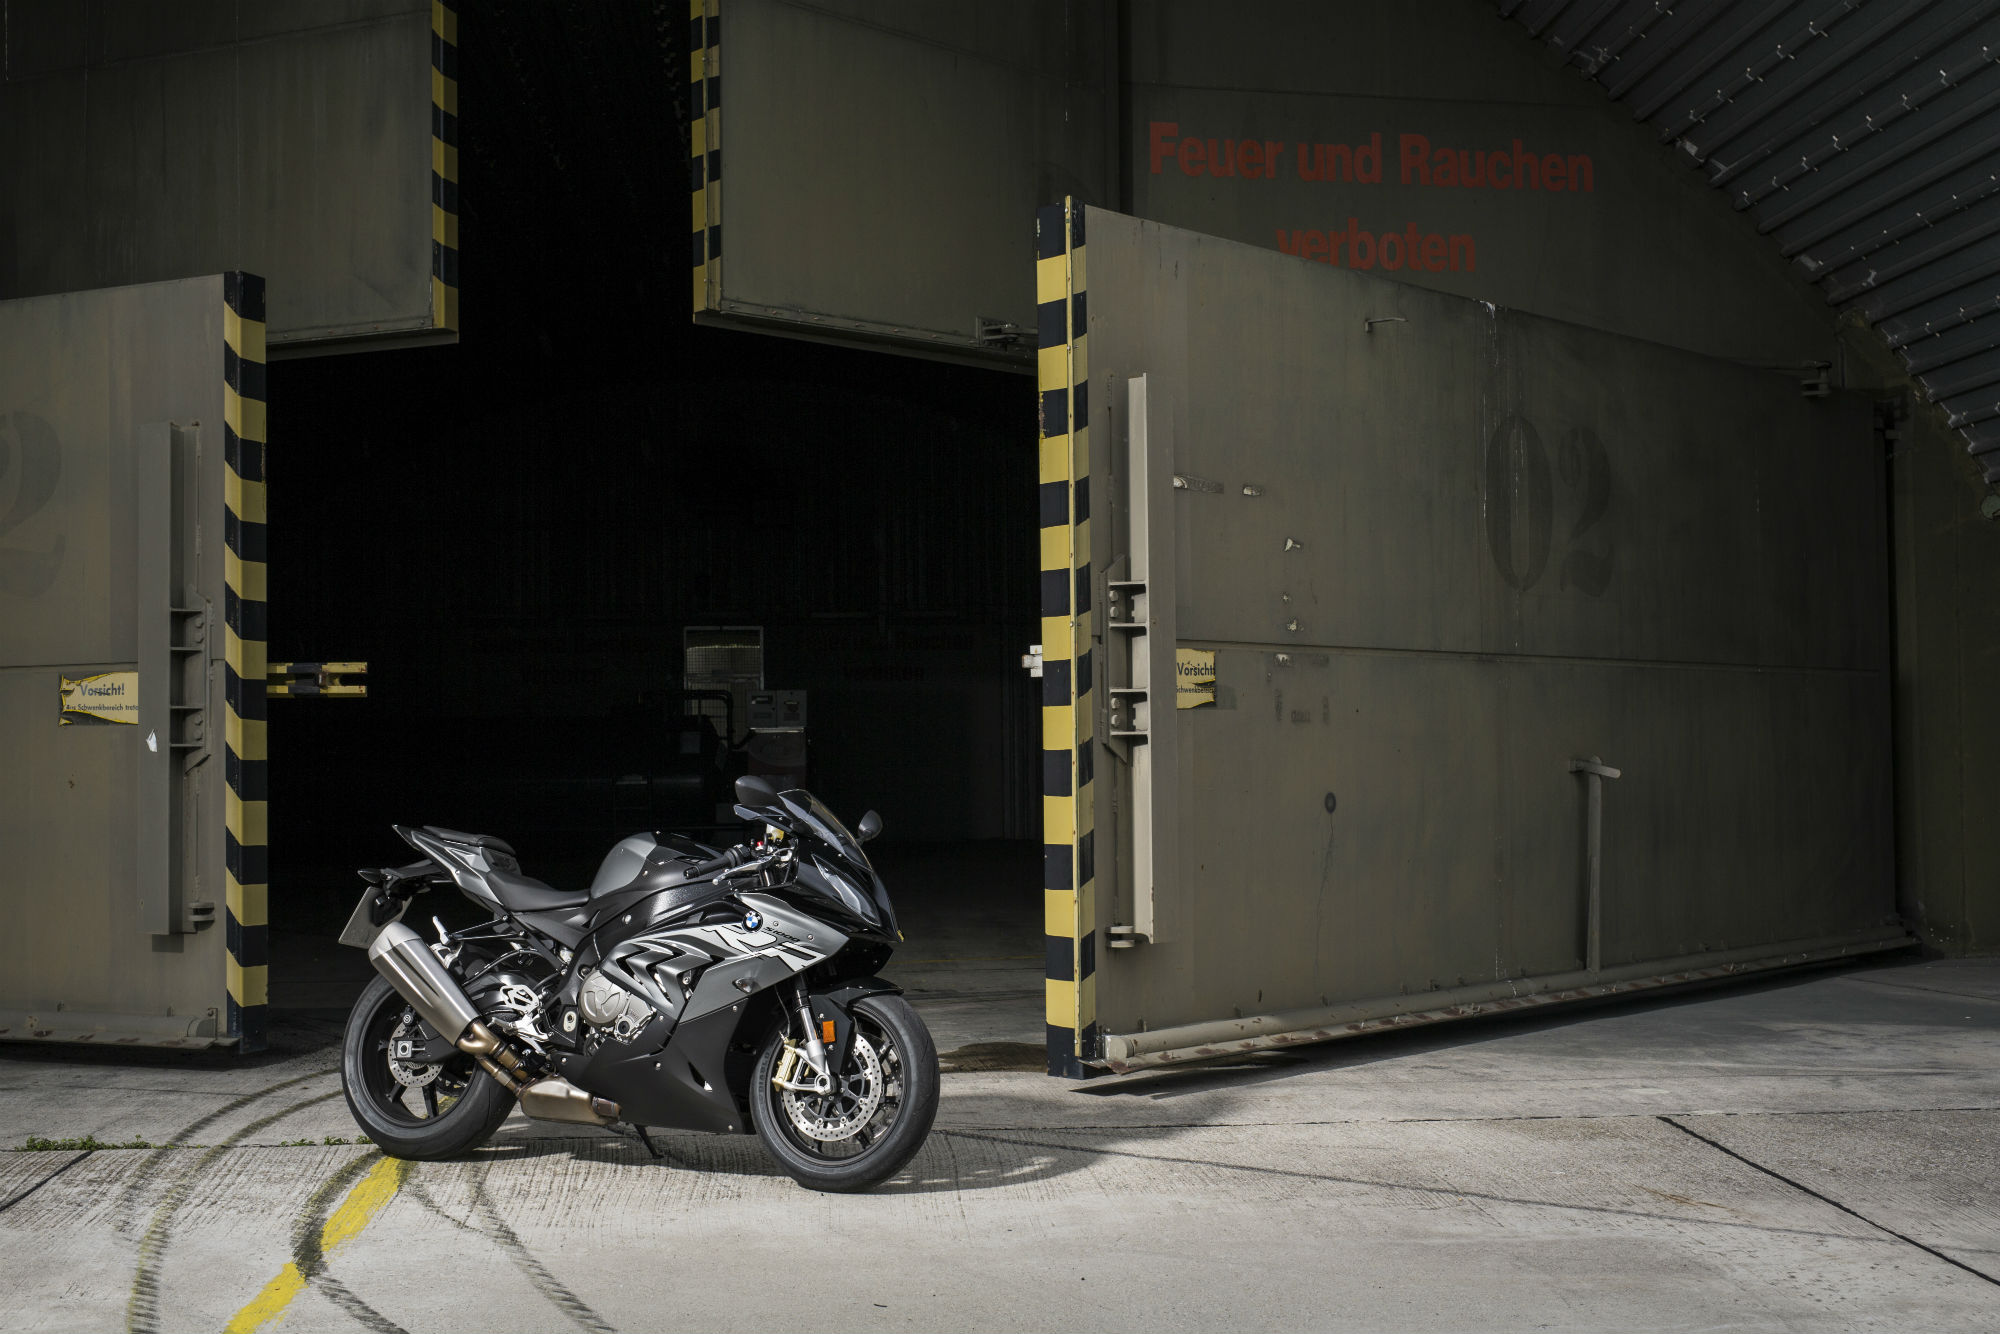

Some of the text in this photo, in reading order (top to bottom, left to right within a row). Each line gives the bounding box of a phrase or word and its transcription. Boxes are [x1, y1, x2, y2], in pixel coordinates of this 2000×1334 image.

[1149, 121, 1594, 193] Feuer und Rauchen
[1275, 216, 1476, 273] verboten
[1485, 415, 1614, 598] 02
[80, 682, 125, 696] Vorsicht!
